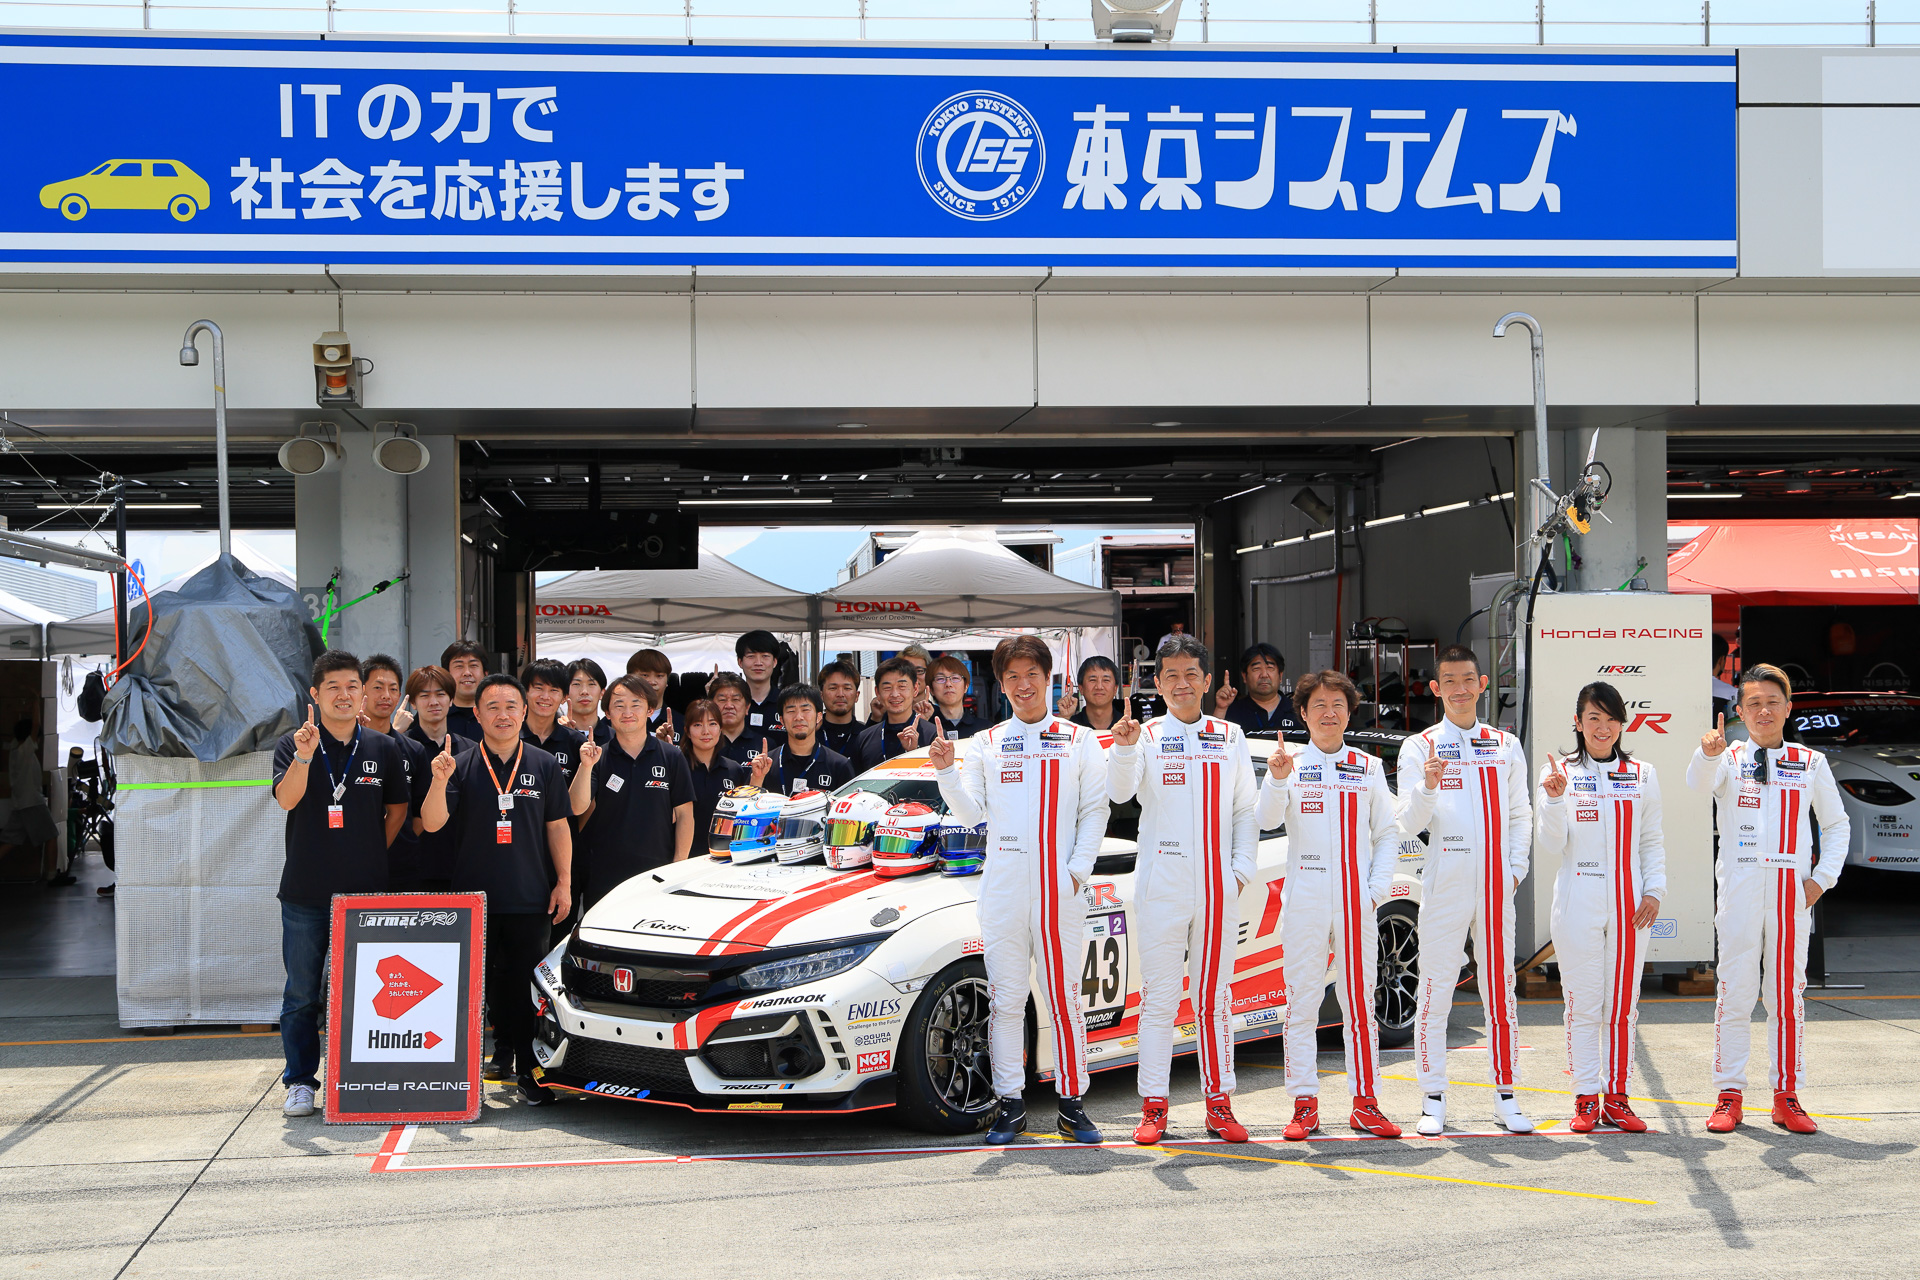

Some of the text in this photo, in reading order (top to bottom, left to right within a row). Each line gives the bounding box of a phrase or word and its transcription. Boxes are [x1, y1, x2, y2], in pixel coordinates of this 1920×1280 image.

[928, 99, 1033, 137] TOKYO SYSTEMS
[1063, 103, 1577, 214] 東京システムズ
[230, 157, 745, 222] 社会を応援します
[933, 181, 1026, 213] SINCE 1970
[1829, 531, 1919, 543] NISSAN
[535, 604, 613, 616] ONDA
[834, 601, 923, 613] HONDA
[1541, 628, 1703, 639] Honda RACING
[1625, 713, 1672, 734] R
[1795, 714, 1840, 732] 230
[1342, 731, 1408, 742] ACING
[1002, 771, 1021, 780] NGK
[1333, 784, 1368, 792] RACING
[1772, 780, 1807, 789] RACING
[1303, 802, 1322, 810] NGK
[1740, 796, 1759, 805] NGK
[826, 818, 857, 827] HONDA
[875, 827, 911, 839] HONDA
[940, 827, 977, 835] HONDA
[753, 885, 790, 895] Dreams
[1390, 884, 1410, 897] BBS
[359, 911, 419, 928] Tarmac
[1113, 917, 1122, 933] 2
[1082, 937, 1120, 1008] 43
[682, 992, 698, 1001] R
[1230, 993, 1267, 1008] Honda
[847, 997, 902, 1021] ENDLESS
[1245, 1010, 1277, 1024] sparco
[847, 1023, 871, 1031] Challenge
[1420, 978, 1433, 1073] Honda RACING
[368, 1029, 423, 1049] Honda
[863, 1031, 891, 1040] OGURA
[863, 1037, 892, 1046] CLUTCH
[1080, 1026, 1088, 1073] Honda
[1222, 1024, 1231, 1073] Honda
[1715, 1024, 1723, 1074] RACING
[859, 1051, 888, 1068] NGK
[335, 1081, 471, 1091] Honda RACING
[594, 1082, 640, 1097] KSBF
